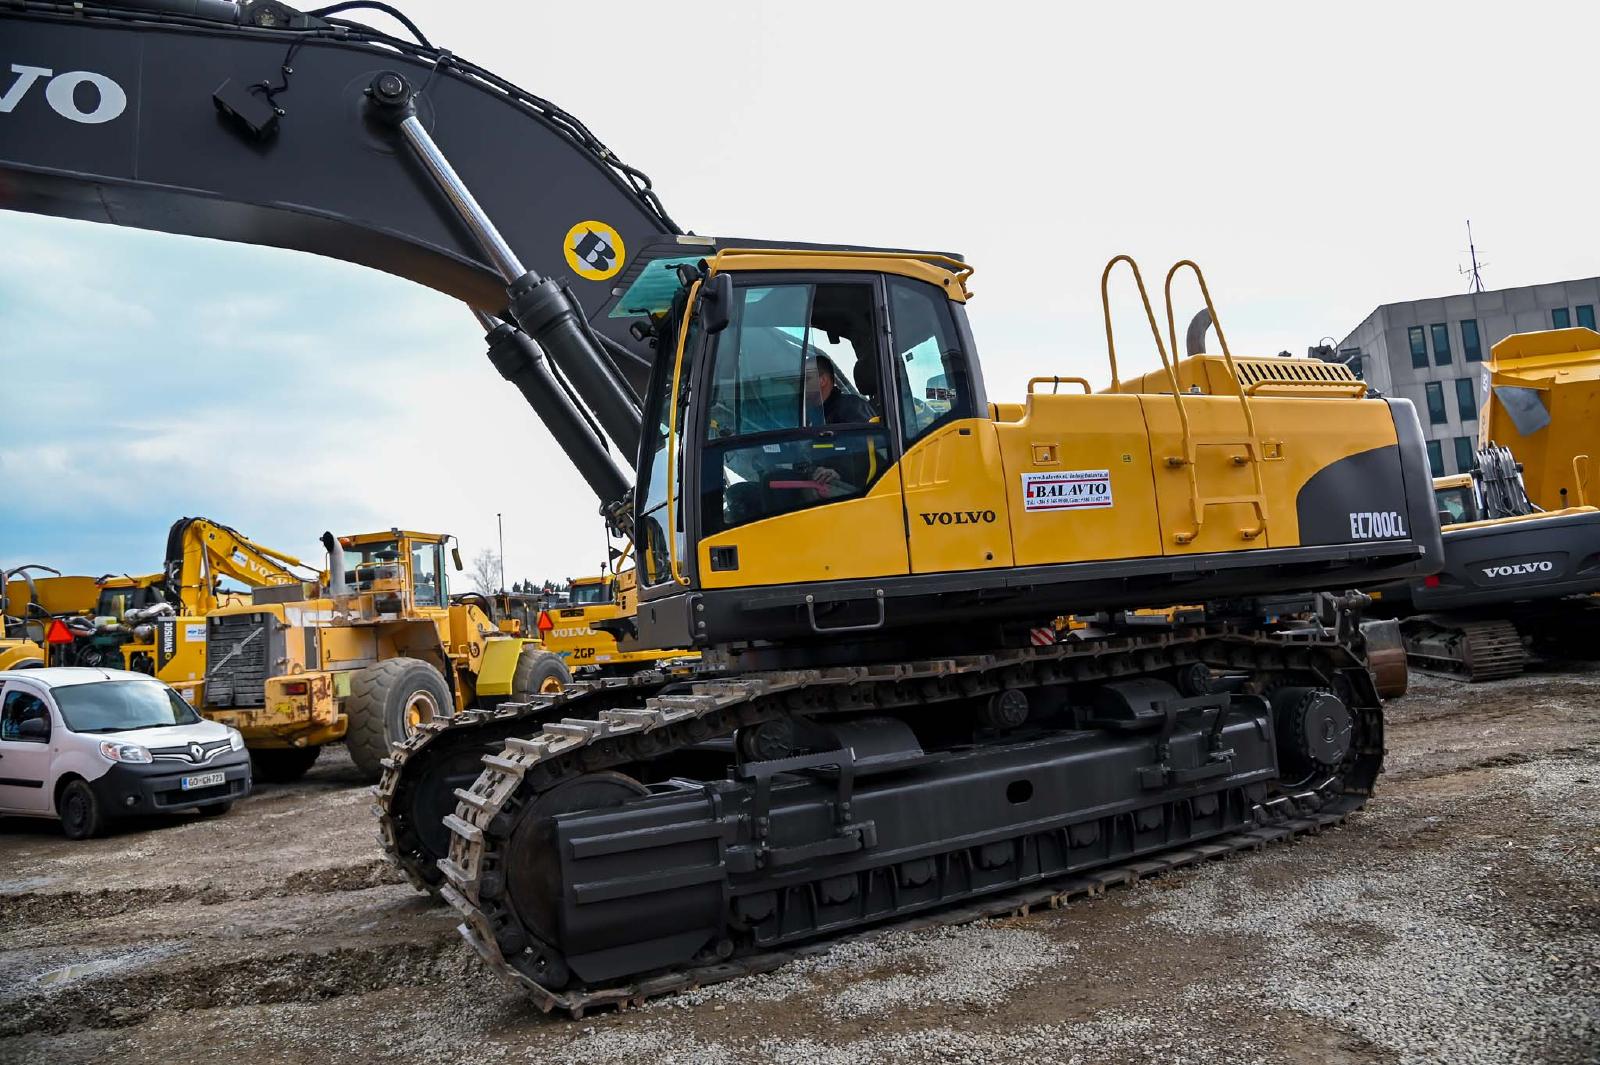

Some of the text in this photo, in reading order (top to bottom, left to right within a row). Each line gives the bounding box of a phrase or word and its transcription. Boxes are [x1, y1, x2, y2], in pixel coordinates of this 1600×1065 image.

[1036, 483, 1107, 498] BALAVTO
[919, 510, 996, 526] VOLVO
[1349, 511, 1407, 539] EC700CL
[1481, 561, 1553, 578] VOLVO
